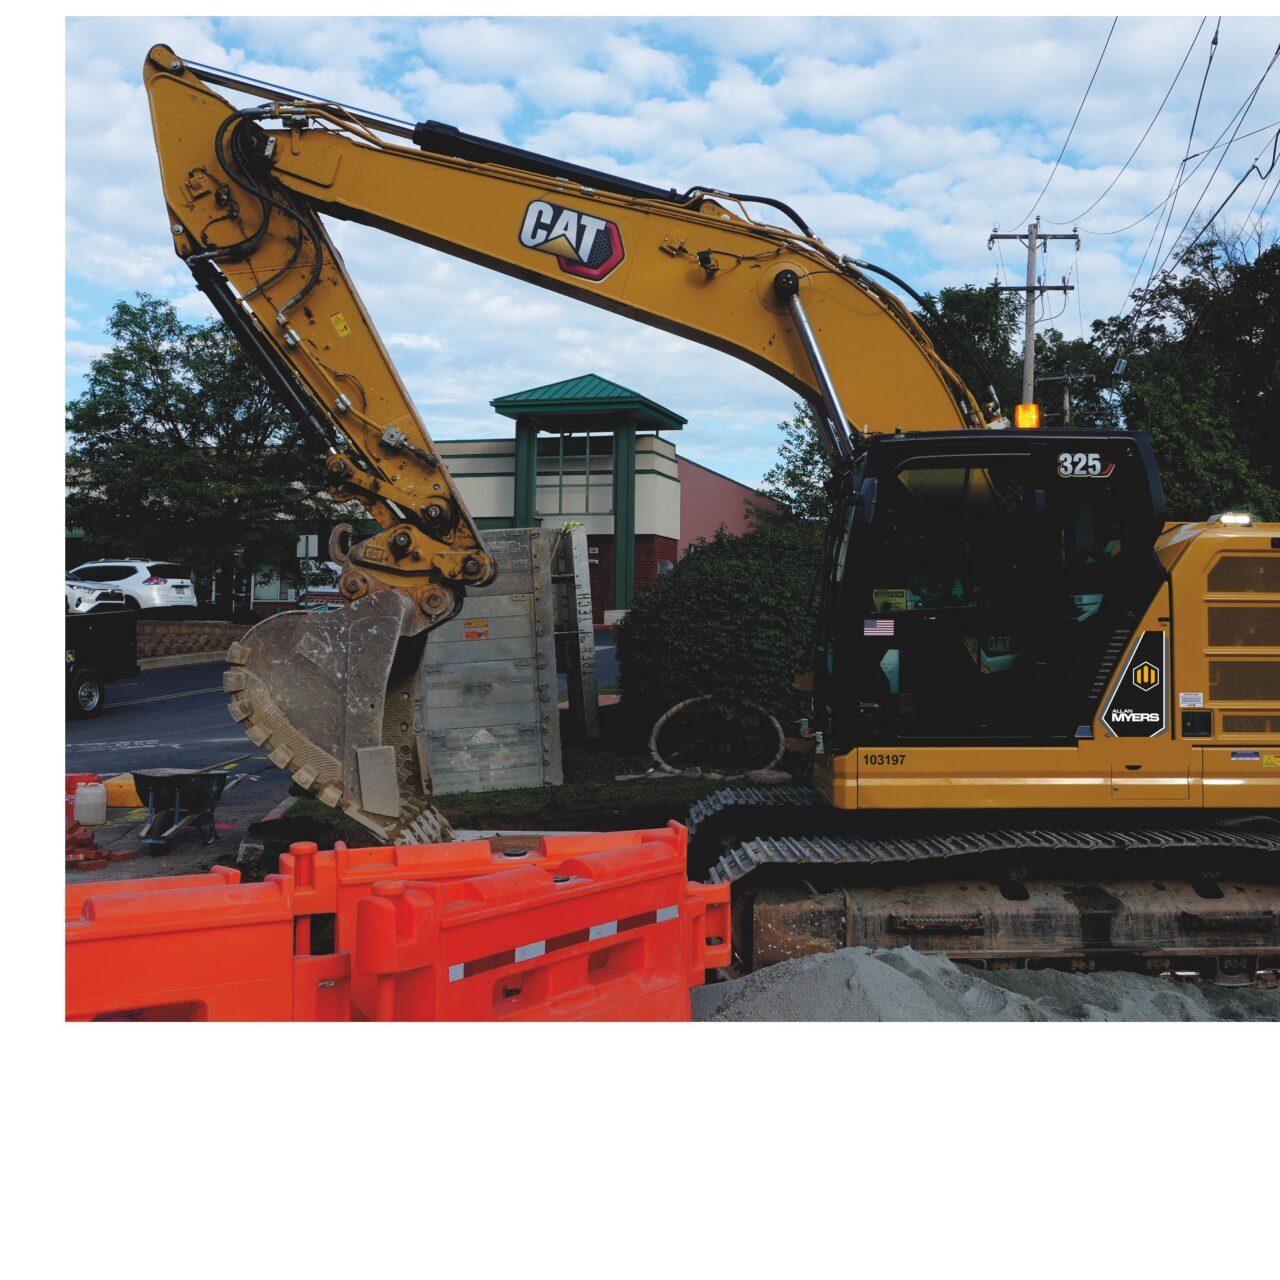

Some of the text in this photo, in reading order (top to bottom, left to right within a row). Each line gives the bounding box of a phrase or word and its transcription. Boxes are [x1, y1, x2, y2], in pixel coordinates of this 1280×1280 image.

[520, 200, 607, 263] CAT
[1059, 452, 1102, 476] 325
[1111, 713, 1160, 722] MYERS
[862, 754, 906, 766] 103197
